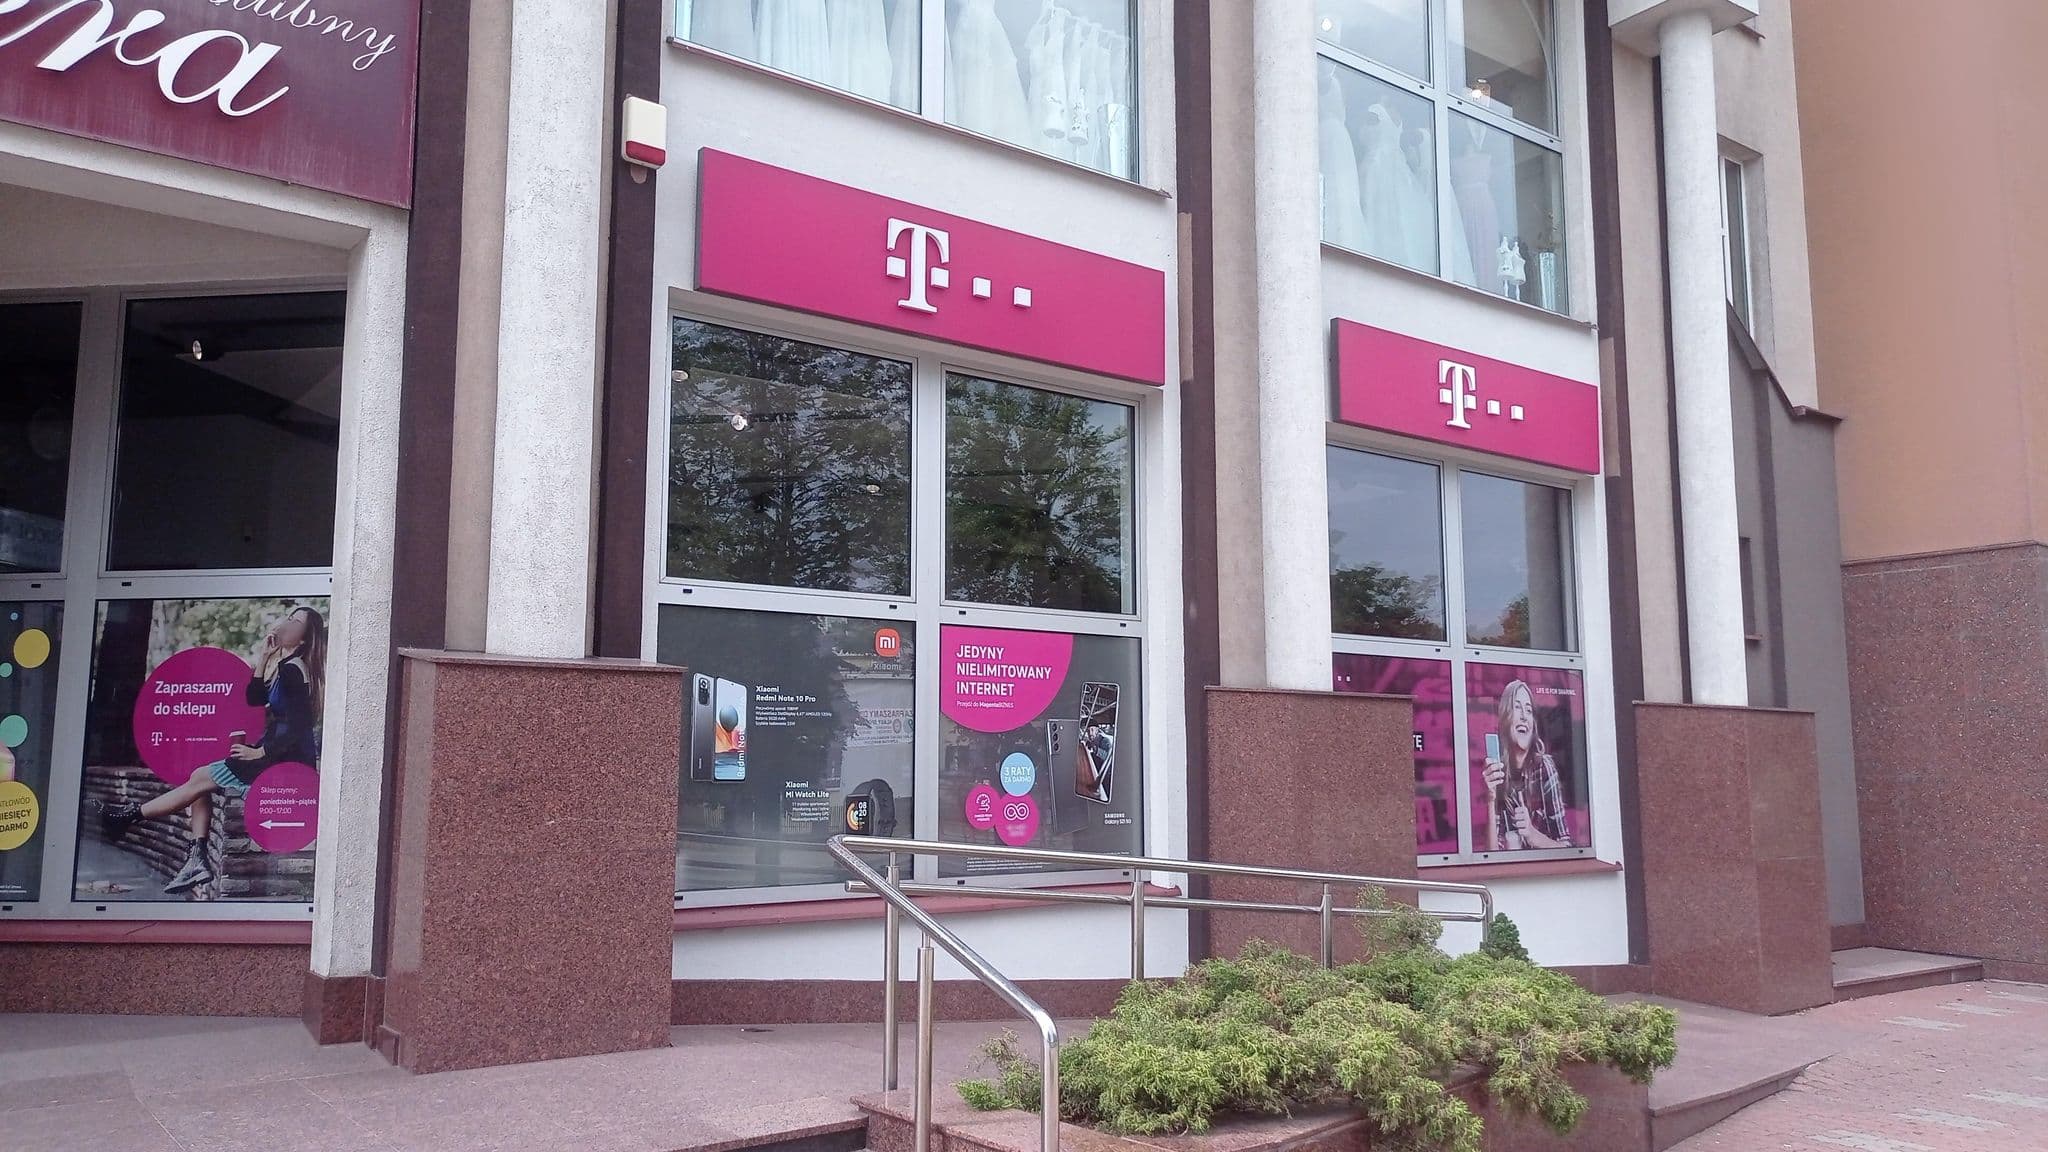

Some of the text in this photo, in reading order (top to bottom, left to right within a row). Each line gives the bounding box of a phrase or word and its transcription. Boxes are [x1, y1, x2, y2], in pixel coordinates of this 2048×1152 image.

[956, 644, 1005, 660] JEDYNY
[956, 662, 1052, 680] NIELIMITOWANY
[155, 680, 234, 697] Zapraszamy
[755, 685, 780, 693] Xiaomi
[956, 681, 1015, 697] INTERNET
[755, 694, 777, 702] Redmi
[796, 695, 804, 703] 10
[804, 695, 817, 703] Pro
[153, 701, 216, 718] do sklepu
[737, 751, 745, 777] Redmi
[1004, 766, 1031, 776] 3 RATY
[785, 781, 809, 789] Xiaomi
[785, 791, 830, 799] Mi Watch Lite
